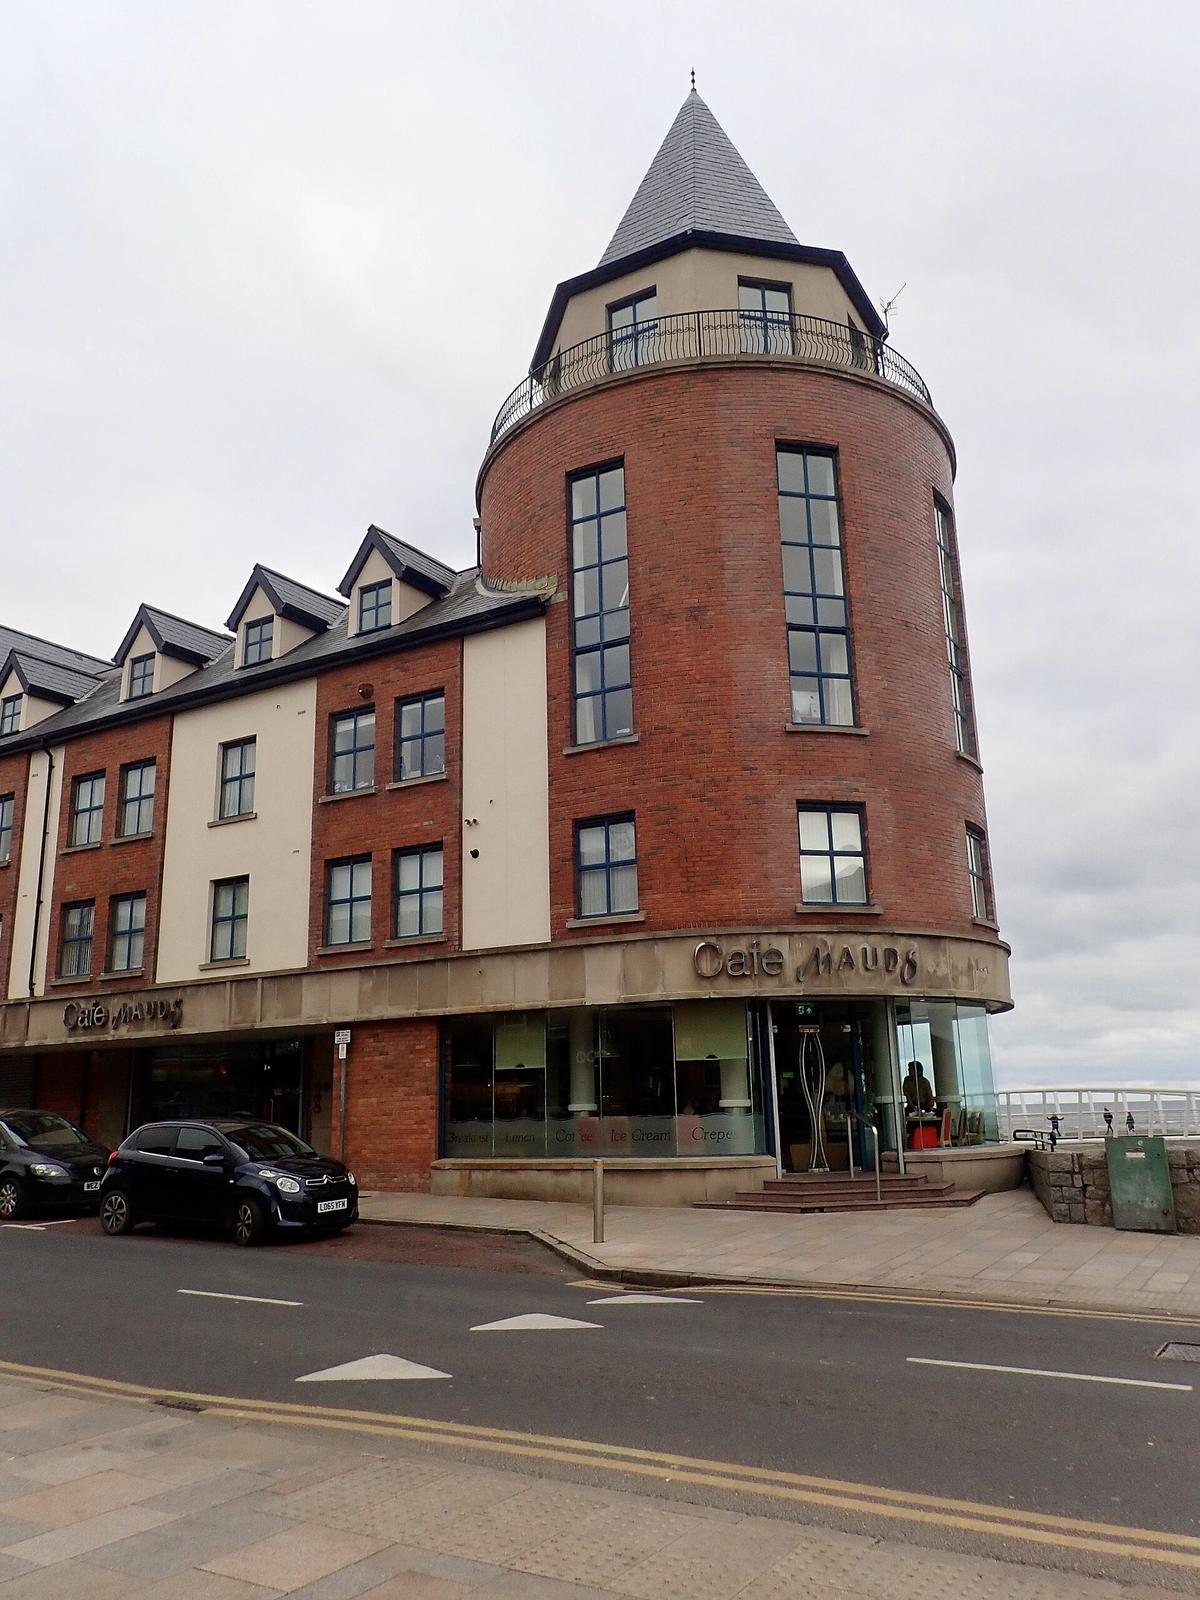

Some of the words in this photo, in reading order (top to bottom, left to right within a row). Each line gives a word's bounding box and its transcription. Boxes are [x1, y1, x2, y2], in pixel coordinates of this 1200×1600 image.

[796, 944, 917, 985] MAUDS
[611, 1129, 627, 1142] Ice
[632, 1128, 671, 1143] Cream
